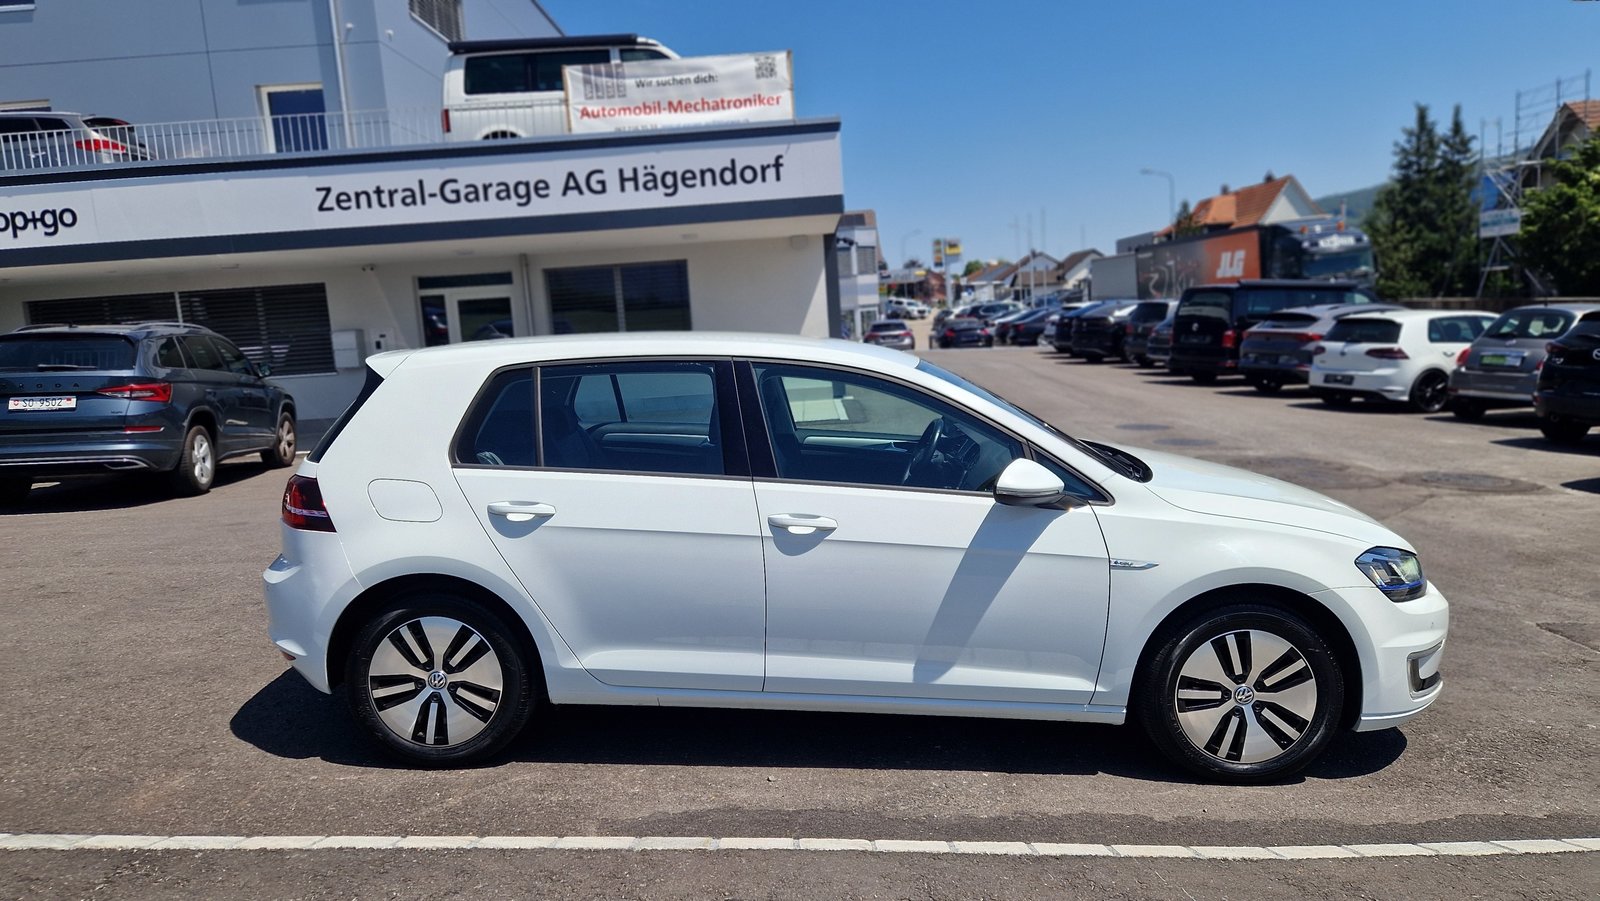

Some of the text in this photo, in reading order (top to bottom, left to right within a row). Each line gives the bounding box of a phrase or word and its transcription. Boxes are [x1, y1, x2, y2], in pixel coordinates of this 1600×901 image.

[635, 77, 655, 89] Wir
[656, 75, 691, 87] suchen
[693, 73, 719, 85] dich:
[579, 93, 782, 120] Automobil-Mechatroniker
[315, 155, 785, 213] Zentral-Garage AG Hägendorf
[1216, 250, 1246, 279] JLG
[39, 397, 63, 408] 9502
